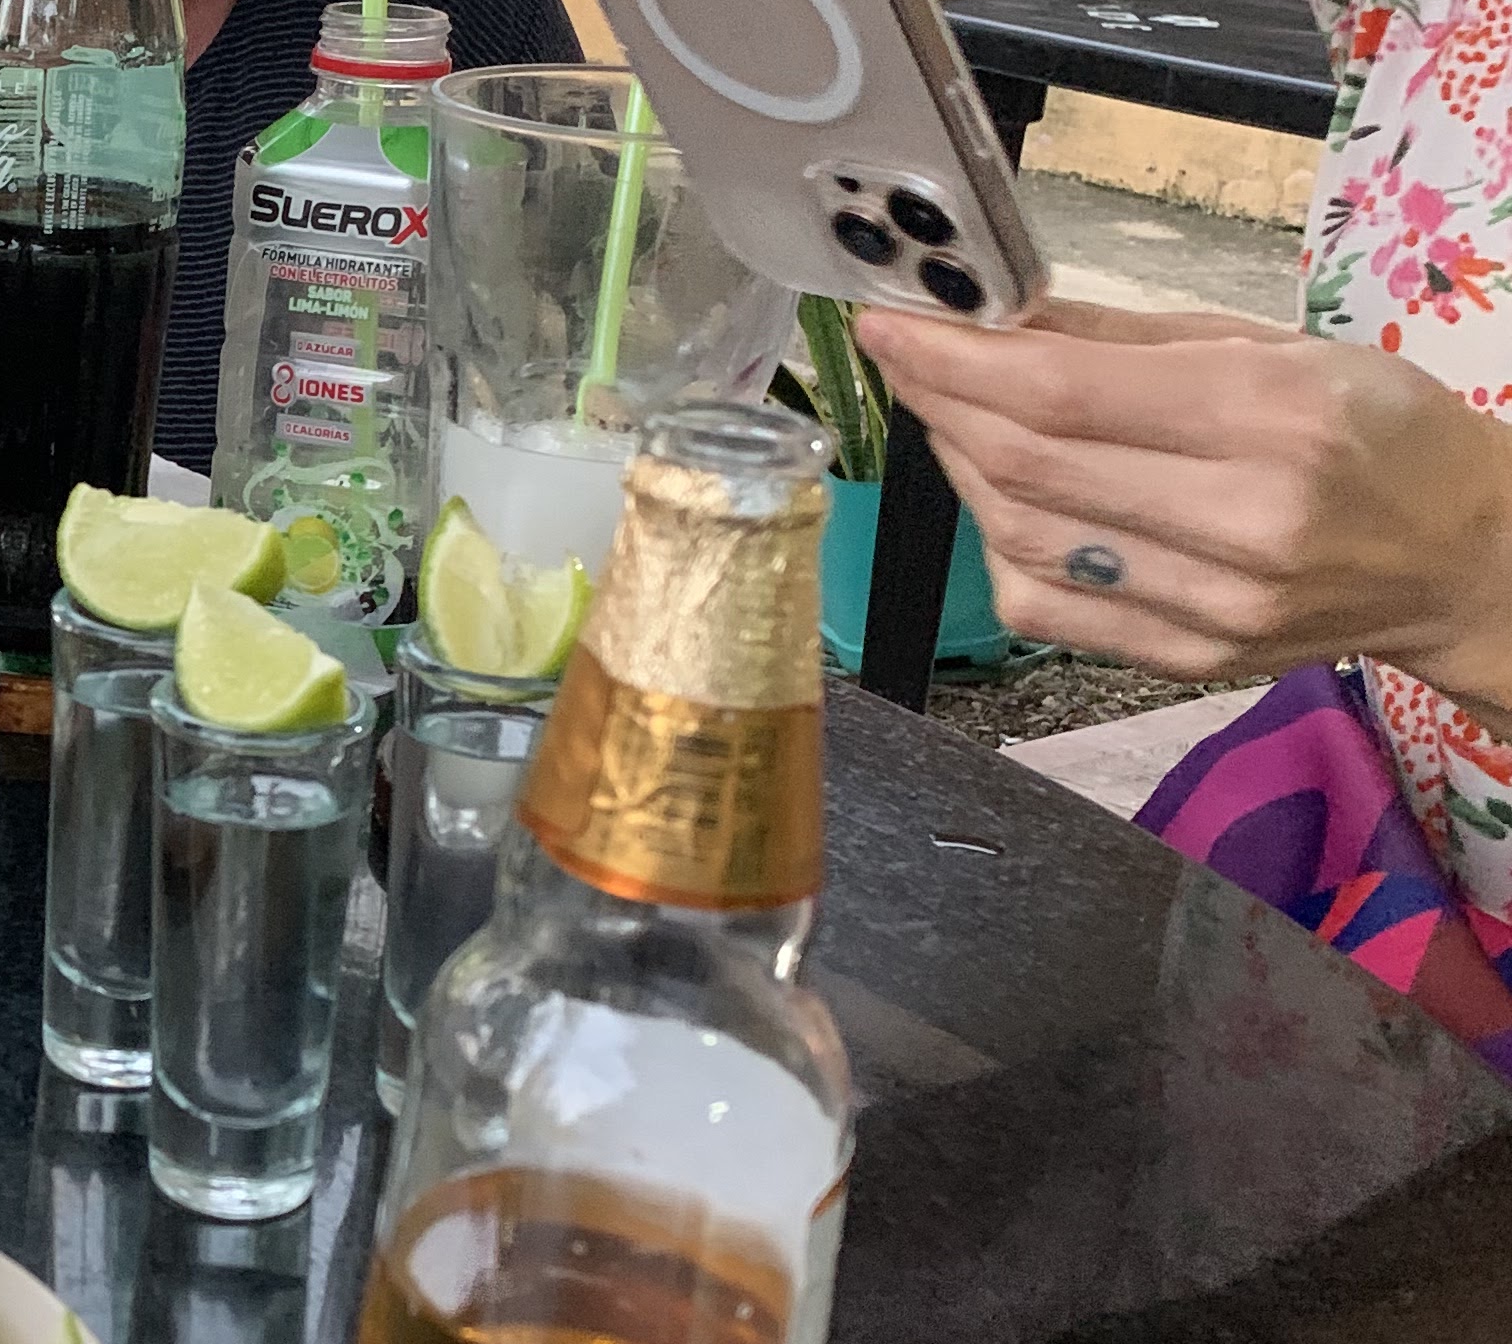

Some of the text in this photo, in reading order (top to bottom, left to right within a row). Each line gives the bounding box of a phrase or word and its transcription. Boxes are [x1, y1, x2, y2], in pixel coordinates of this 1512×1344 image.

[250, 184, 429, 245] SUEROX
[270, 265, 397, 291] CON ELECTROLITOS
[325, 257, 411, 278] HIDRATANTE
[308, 285, 352, 303] SABOR
[289, 296, 369, 320] LIMA-LIMÓN
[298, 378, 364, 404] IONES
